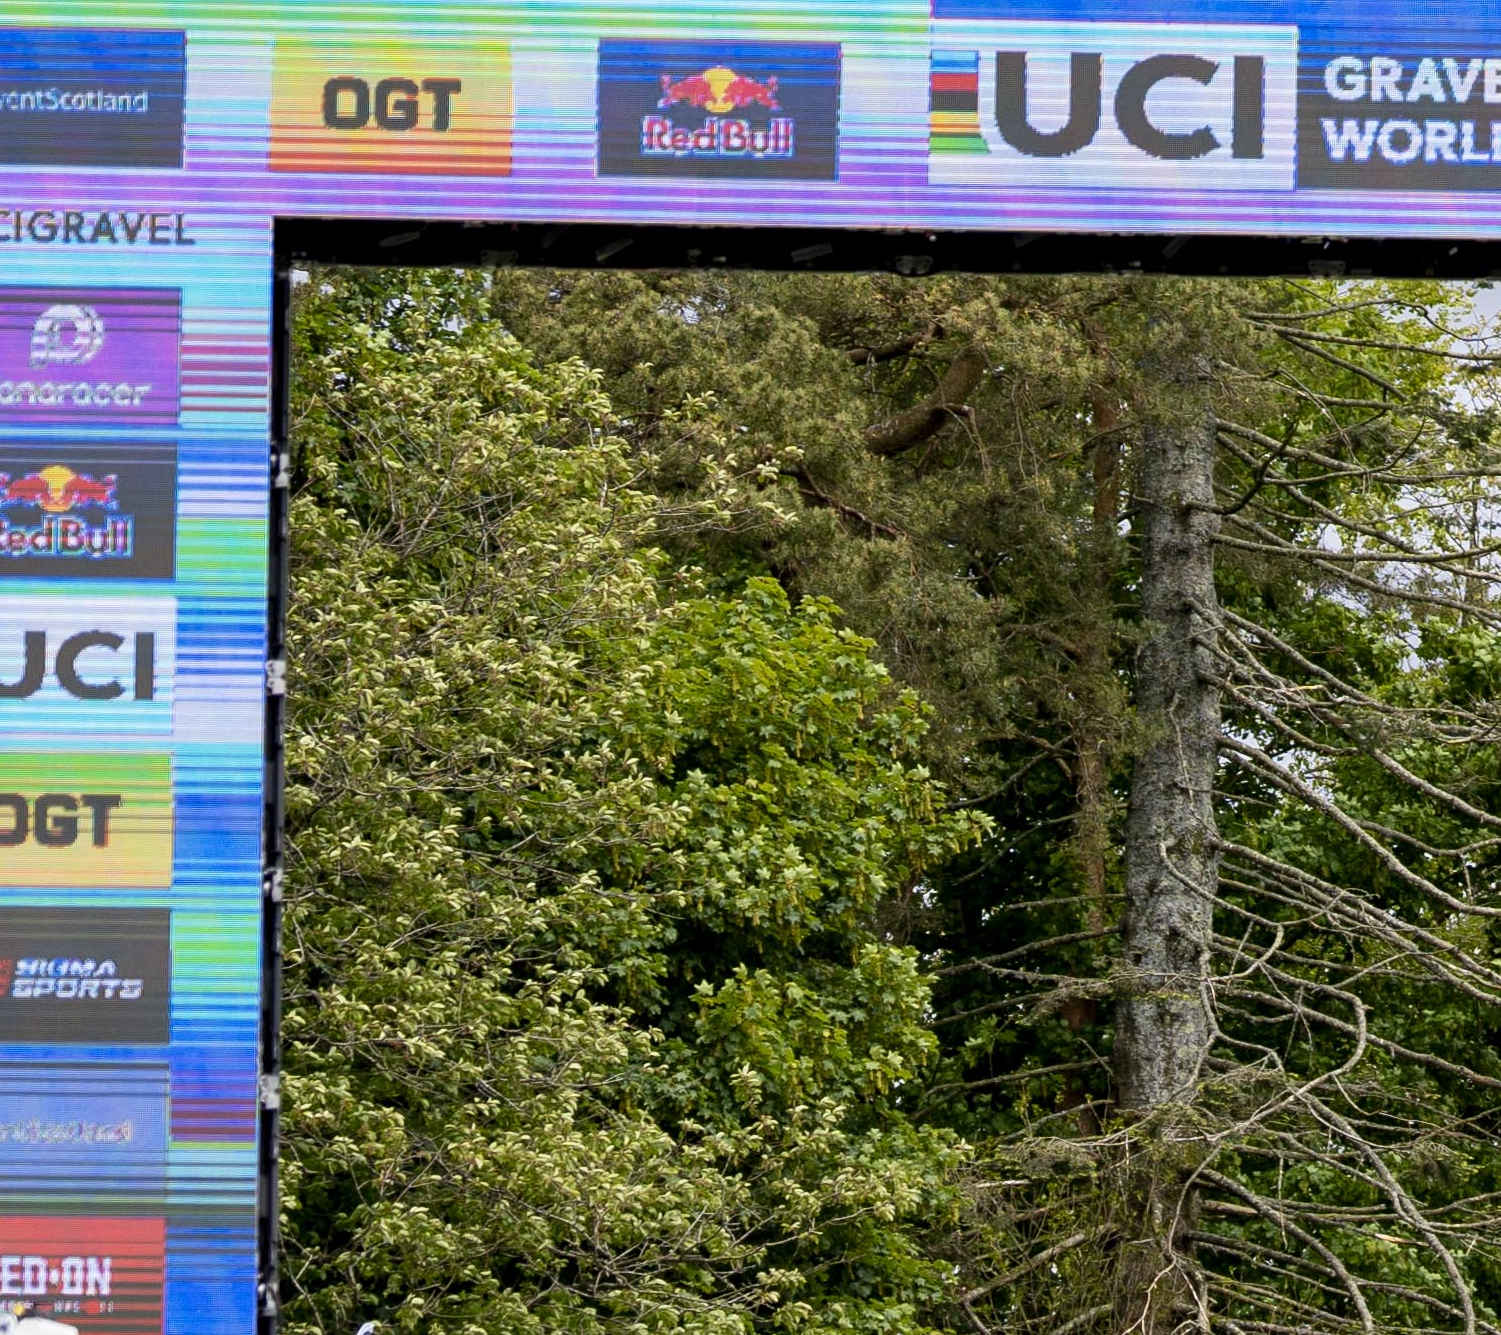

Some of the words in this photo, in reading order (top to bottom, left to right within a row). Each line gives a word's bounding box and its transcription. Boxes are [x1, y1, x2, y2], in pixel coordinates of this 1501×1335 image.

[321, 75, 463, 133] OGT
[992, 50, 1264, 162] UCI
[642, 116, 718, 156] Red
[721, 116, 793, 159] Bull
[56, 515, 133, 557] Bull
[11, 978, 144, 1000] SPORTS
